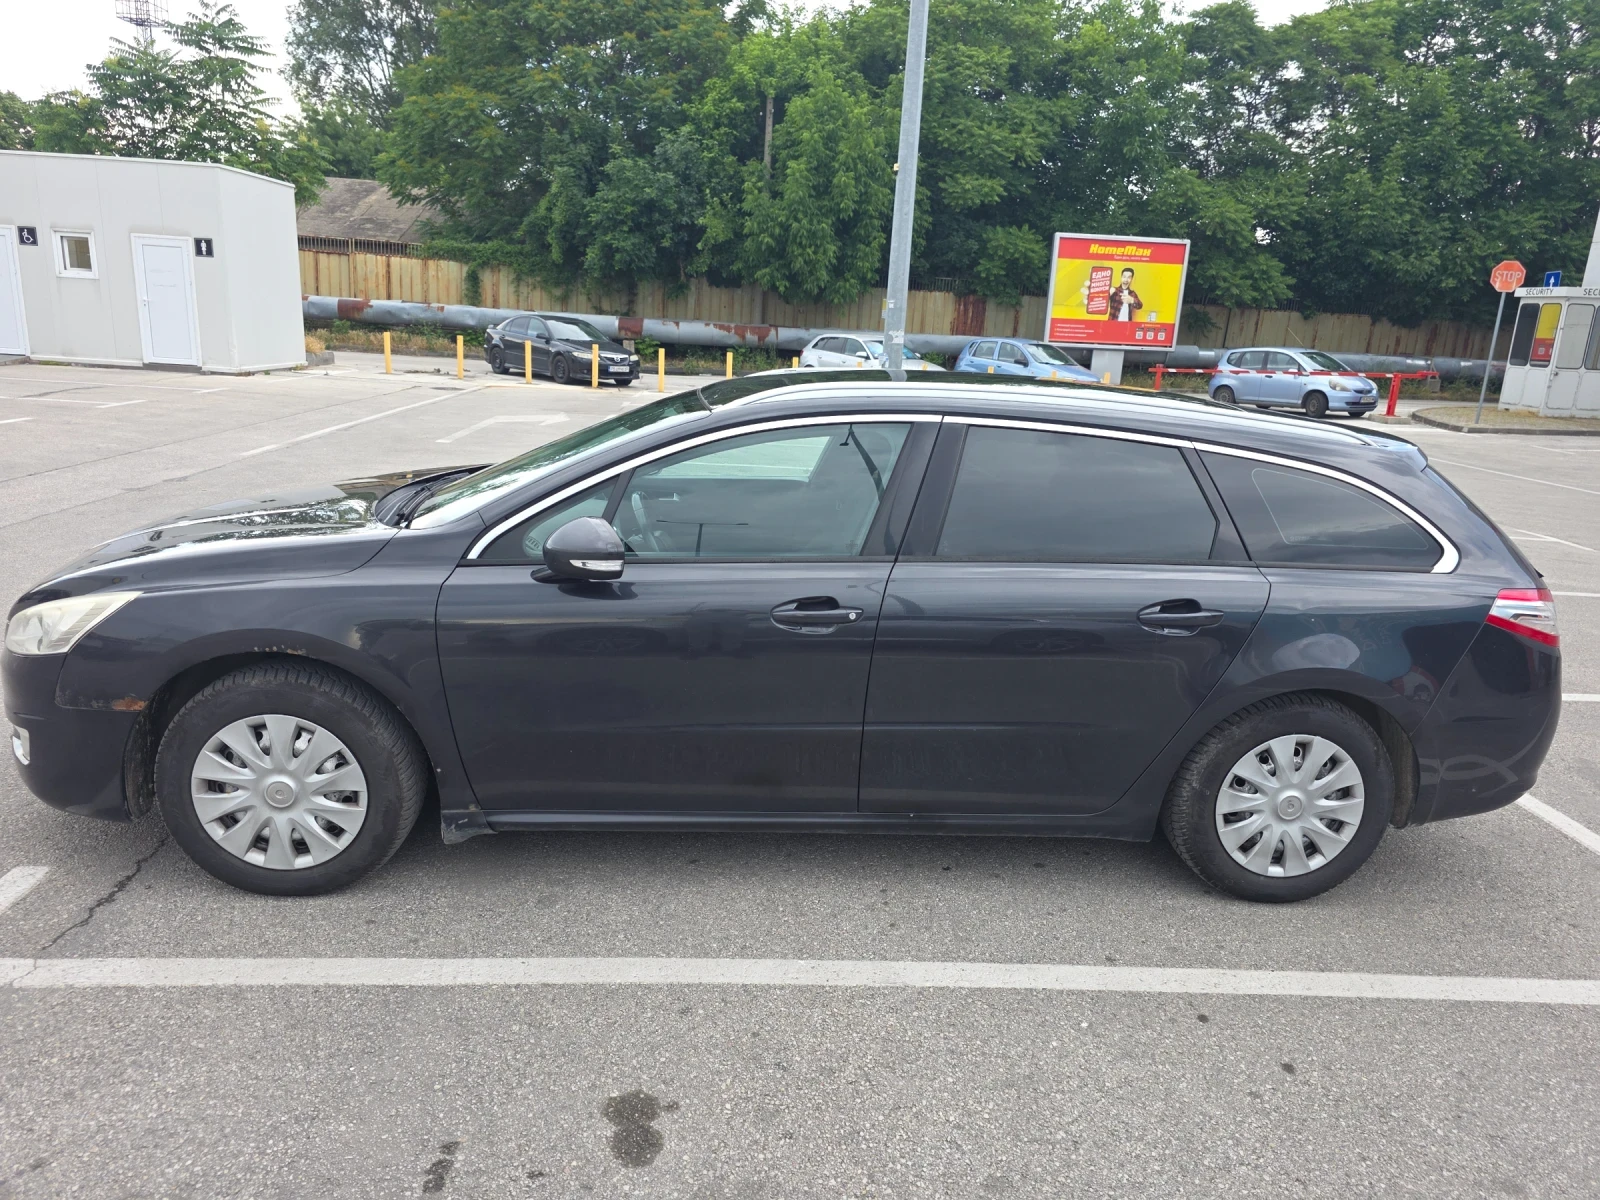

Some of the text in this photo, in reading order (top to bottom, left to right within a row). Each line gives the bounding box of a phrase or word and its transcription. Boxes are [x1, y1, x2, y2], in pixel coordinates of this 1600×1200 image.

[1089, 244, 1151, 256] HomeMax
[1092, 270, 1111, 279] ЕДНО
[1494, 271, 1522, 282] STOP
[1091, 280, 1110, 288] МНОГО
[1525, 288, 1554, 296] SECURITY
[1583, 288, 1600, 296] SEC
